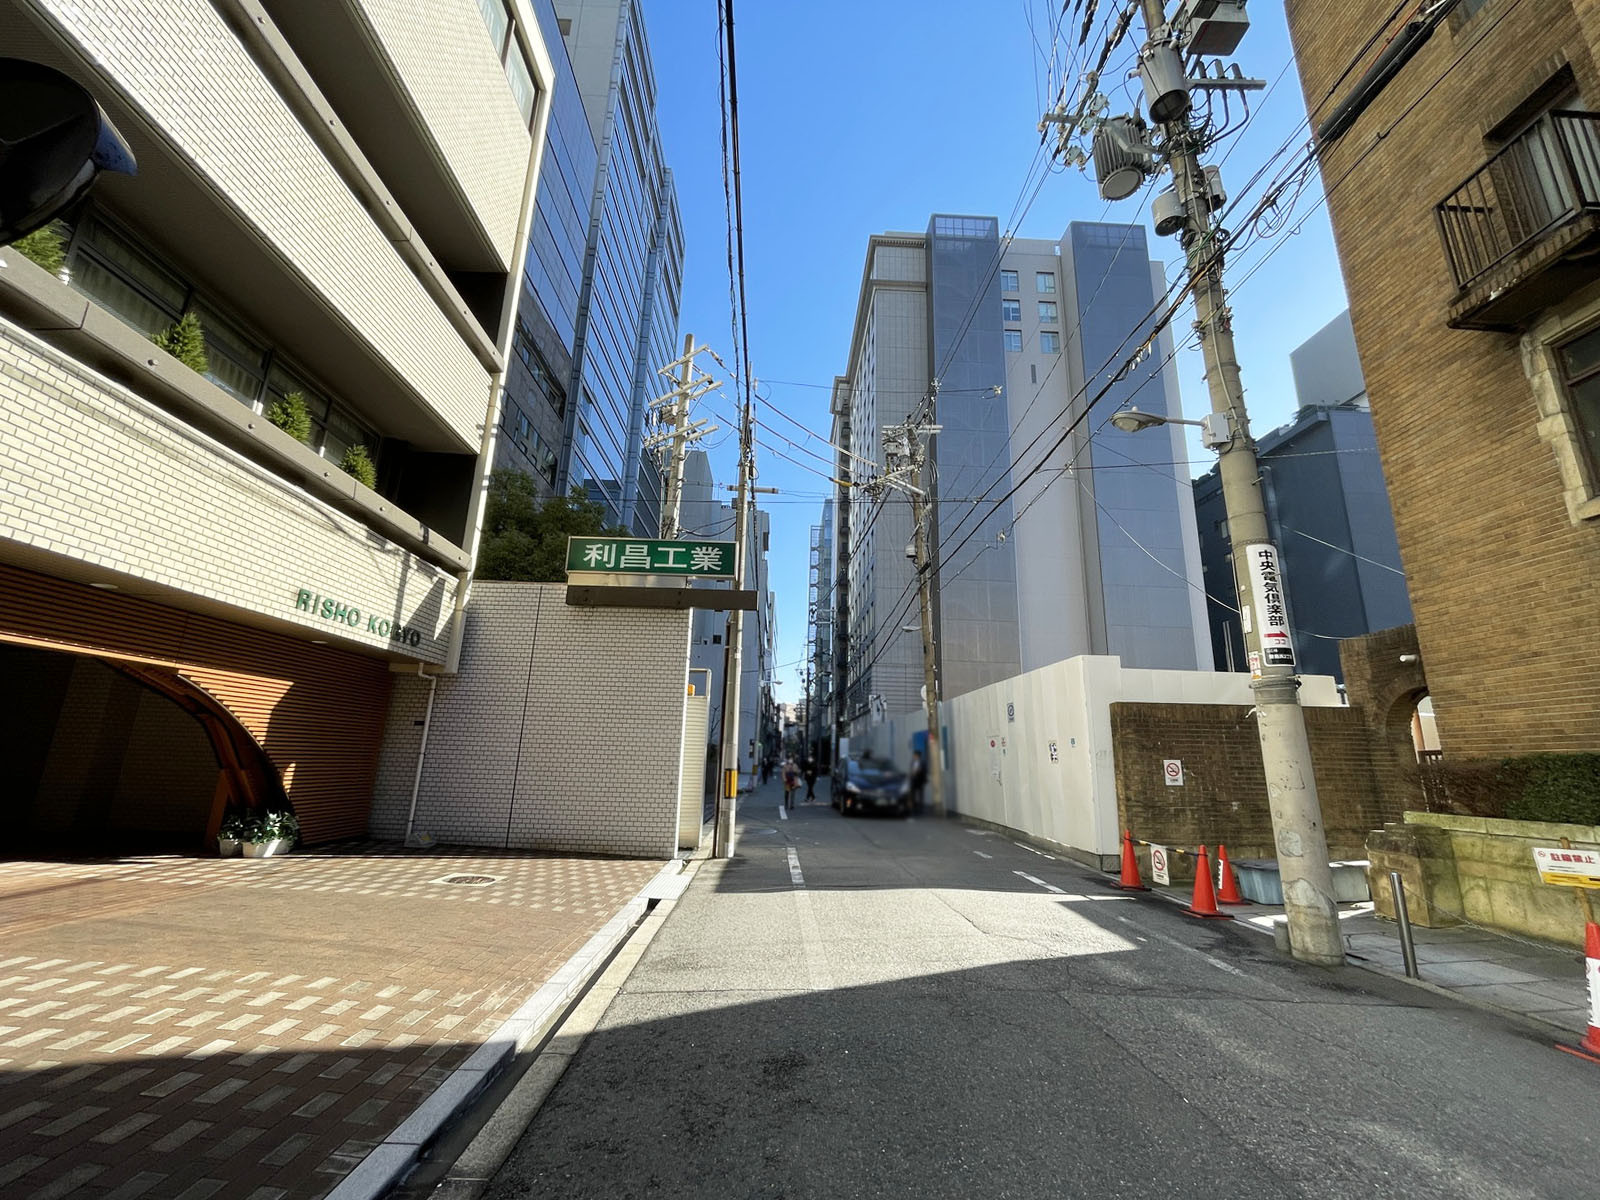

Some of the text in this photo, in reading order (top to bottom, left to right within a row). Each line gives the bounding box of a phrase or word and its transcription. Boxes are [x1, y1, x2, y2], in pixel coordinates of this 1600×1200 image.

[583, 543, 723, 571] 利昌工業
[295, 588, 421, 647] RISHO KOGYO
[1258, 549, 1285, 627] 中央電気倶楽部
